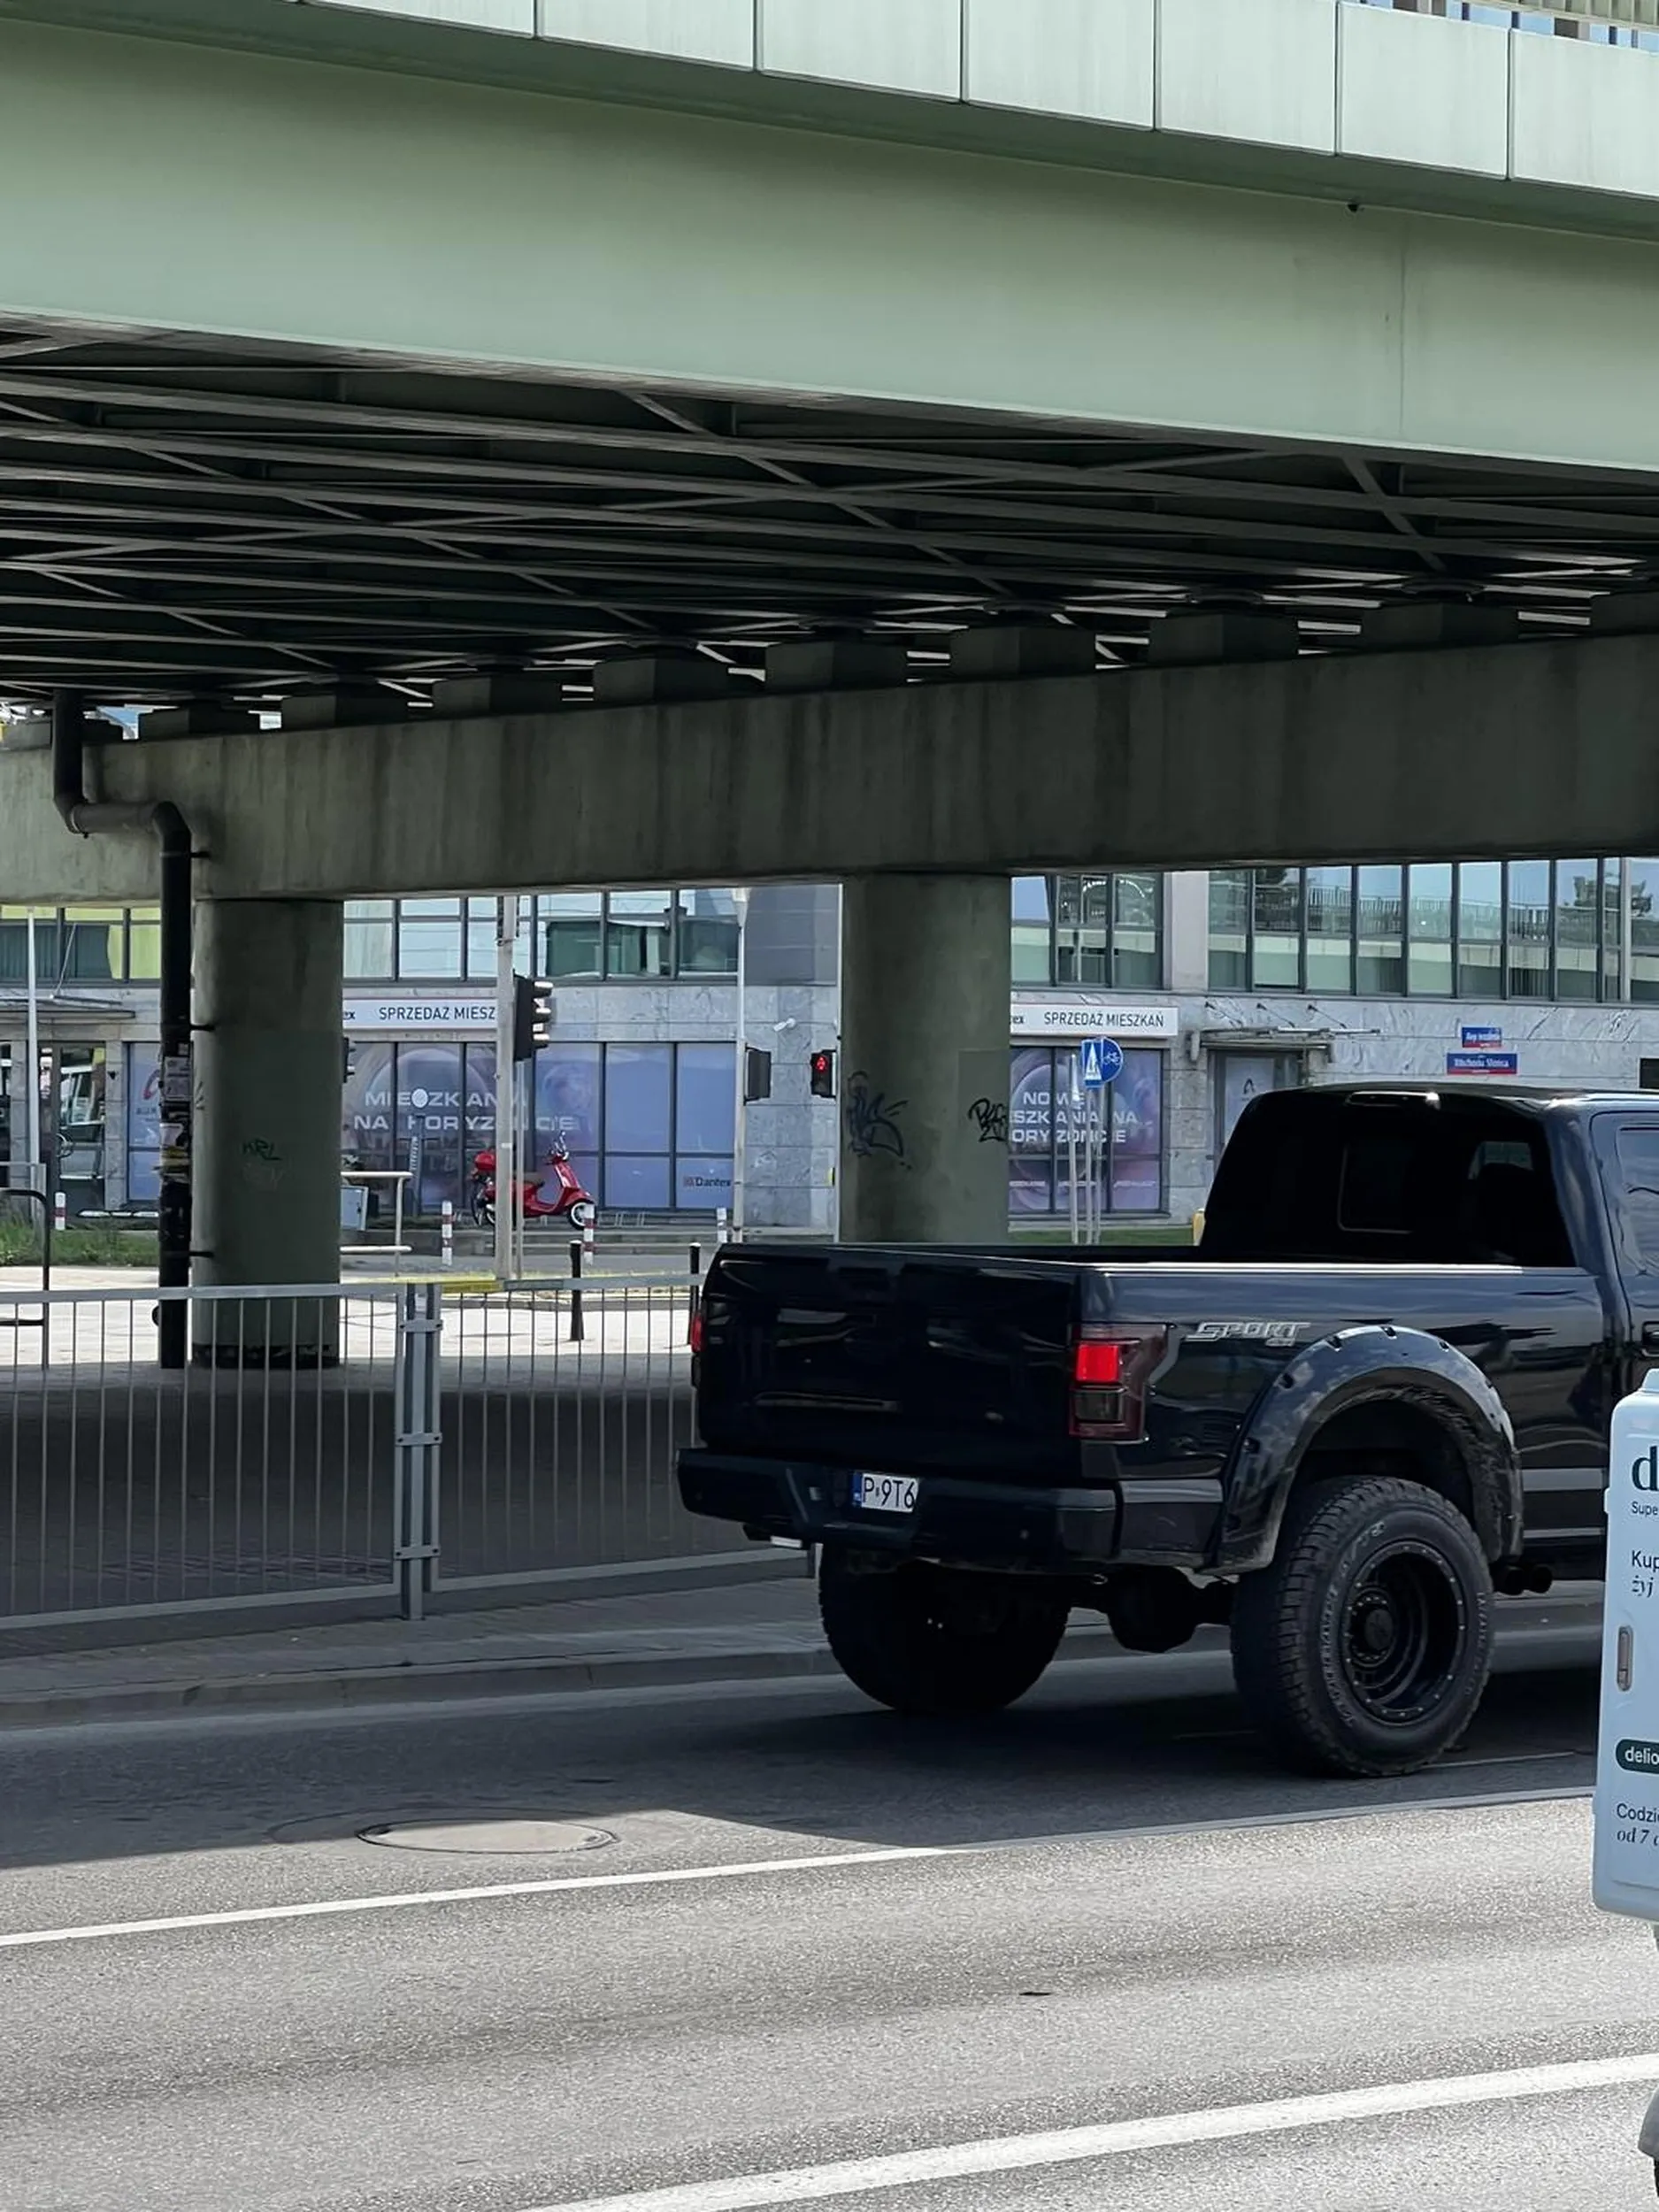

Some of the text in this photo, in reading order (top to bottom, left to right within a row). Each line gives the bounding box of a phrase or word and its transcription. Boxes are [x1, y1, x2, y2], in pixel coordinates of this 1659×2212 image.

[354, 1115, 389, 1131] NA
[1186, 1321, 1312, 1341] SPORT
[1616, 1802, 1659, 1823] Codzi
